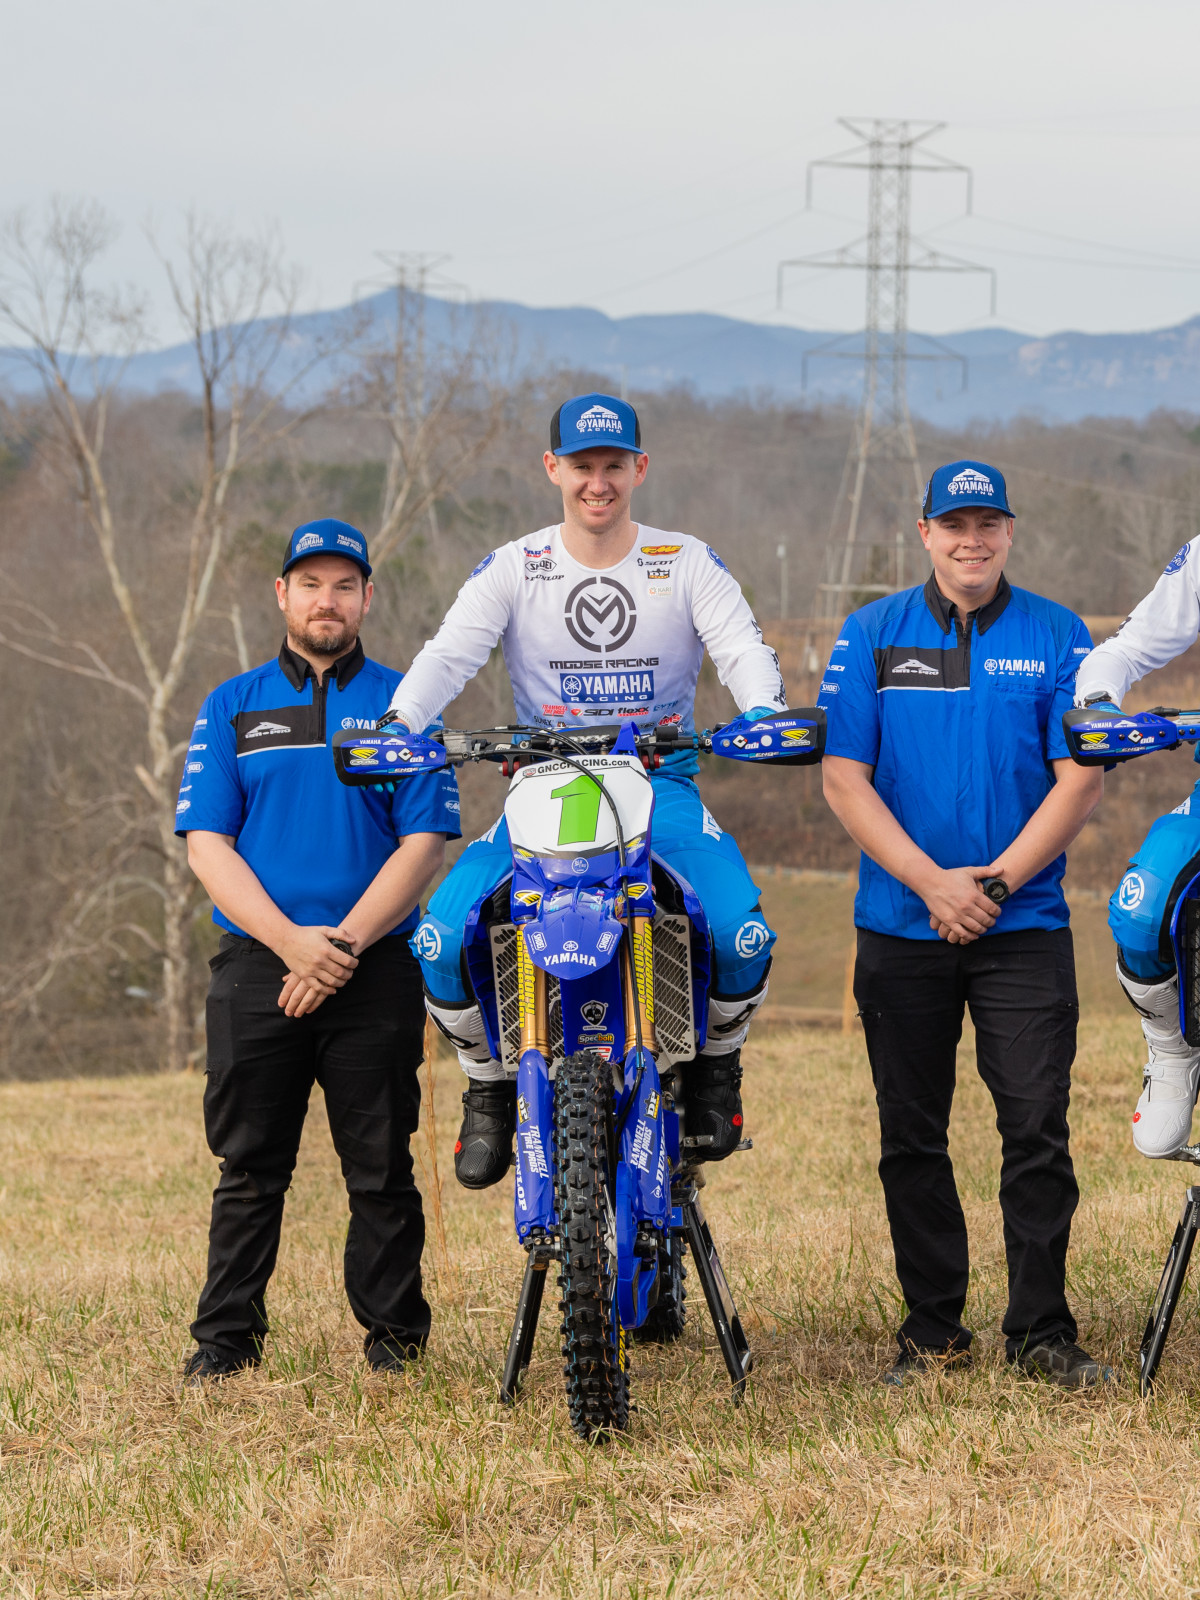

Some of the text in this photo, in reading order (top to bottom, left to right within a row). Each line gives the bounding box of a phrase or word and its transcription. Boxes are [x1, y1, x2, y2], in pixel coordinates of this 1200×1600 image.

[586, 419, 622, 430] YAMAHA
[959, 482, 994, 493] YAMAHA
[549, 657, 659, 670] MOOSE RACING
[998, 659, 1045, 674] YAMAHA
[582, 674, 652, 694] YAMAHA
[356, 719, 377, 730] YAM
[551, 775, 604, 846] 1
[544, 953, 596, 967] YAMAHA
[516, 930, 525, 1028] Connection
[643, 922, 654, 1023] Connection
[578, 1034, 614, 1044] Specbolt
[529, 1125, 549, 1178] TRAMMELL
[630, 1119, 647, 1165] RAMMELL
[637, 1127, 653, 1174] TIRE PROS
[520, 1132, 540, 1174] TIRE PROS
